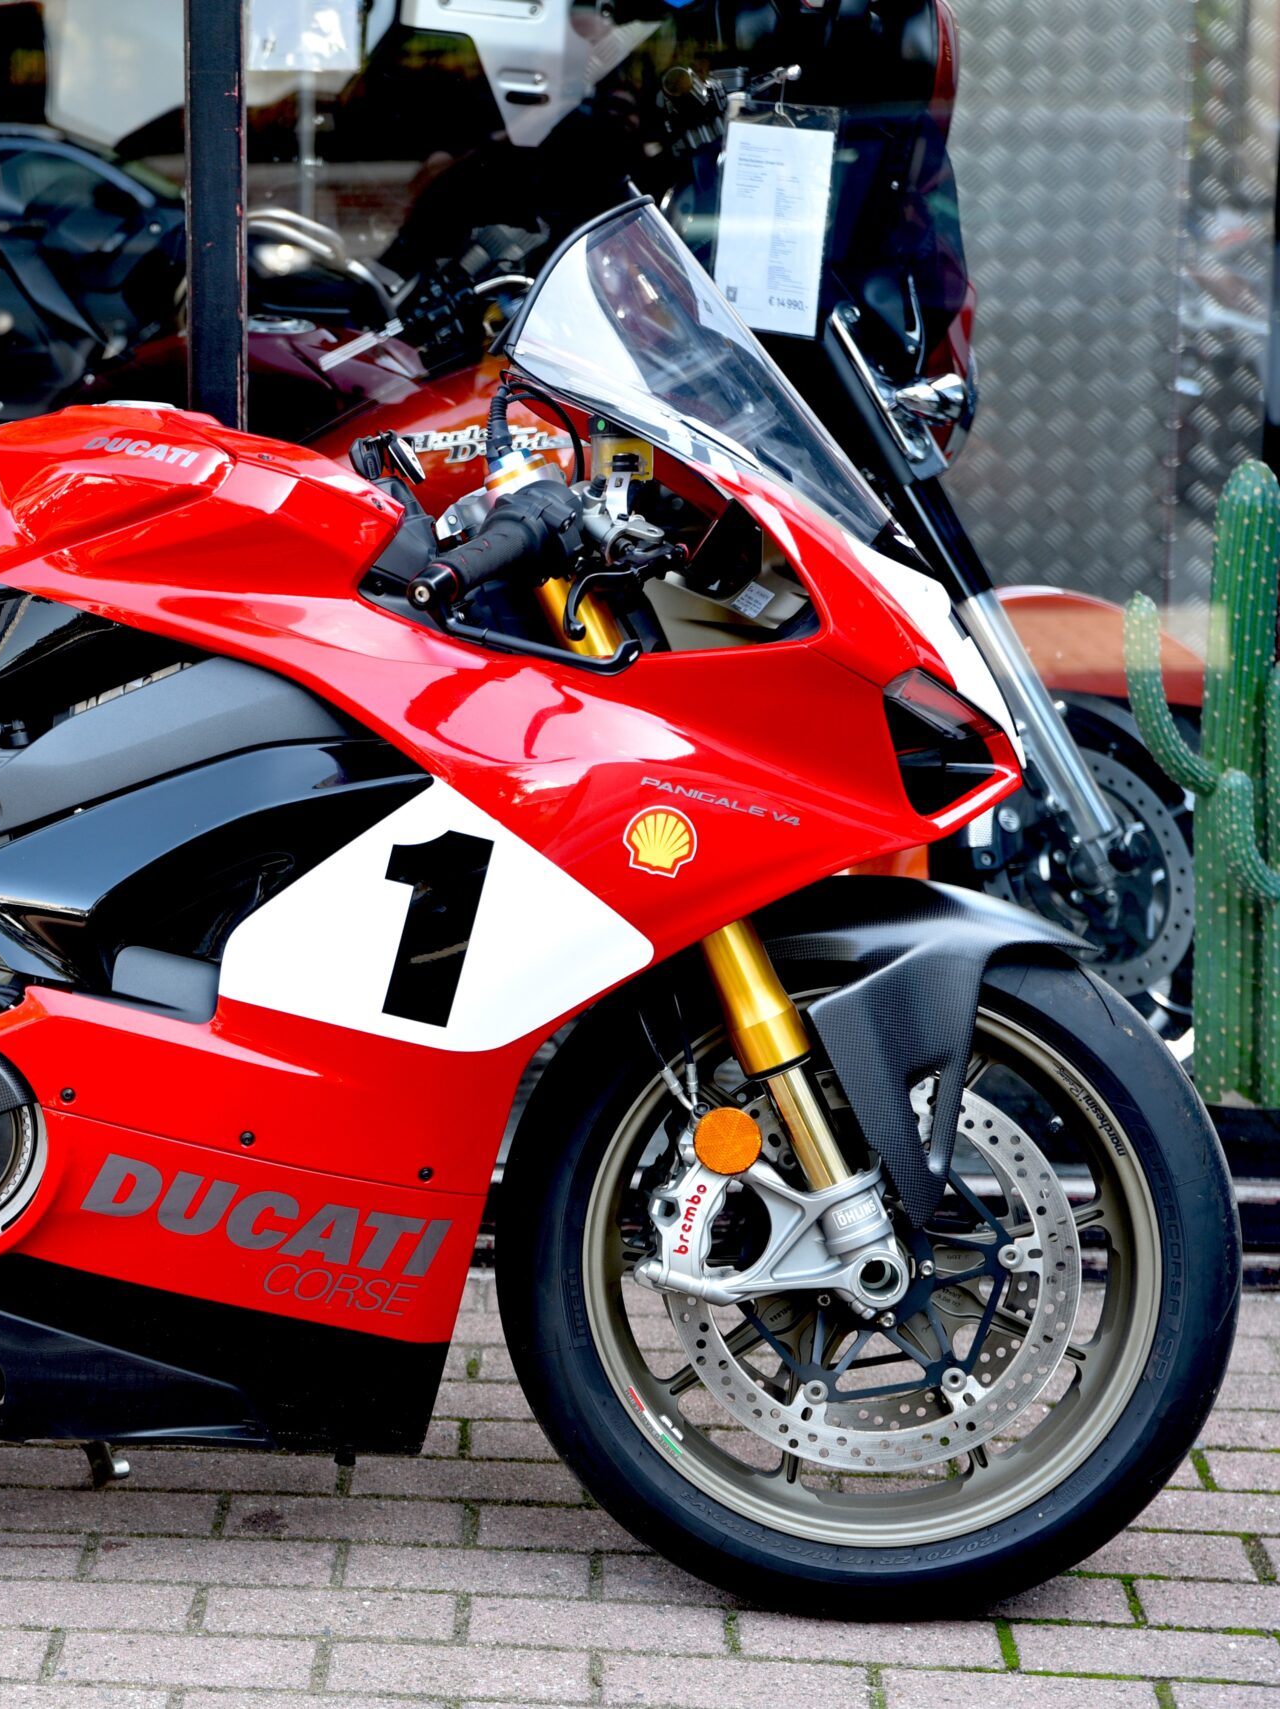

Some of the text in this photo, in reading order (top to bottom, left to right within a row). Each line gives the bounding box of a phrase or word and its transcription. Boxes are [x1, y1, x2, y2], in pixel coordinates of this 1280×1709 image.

[83, 437, 200, 468] DUCATI
[640, 776, 801, 826] PANIGALE V4
[381, 829, 495, 1028] 1
[1078, 1095, 1126, 1157] marchesini
[79, 1153, 454, 1278] DUCATI
[673, 1184, 708, 1256] brembo
[836, 1199, 877, 1227] ÖHLINS
[263, 1262, 418, 1316] CORSE
